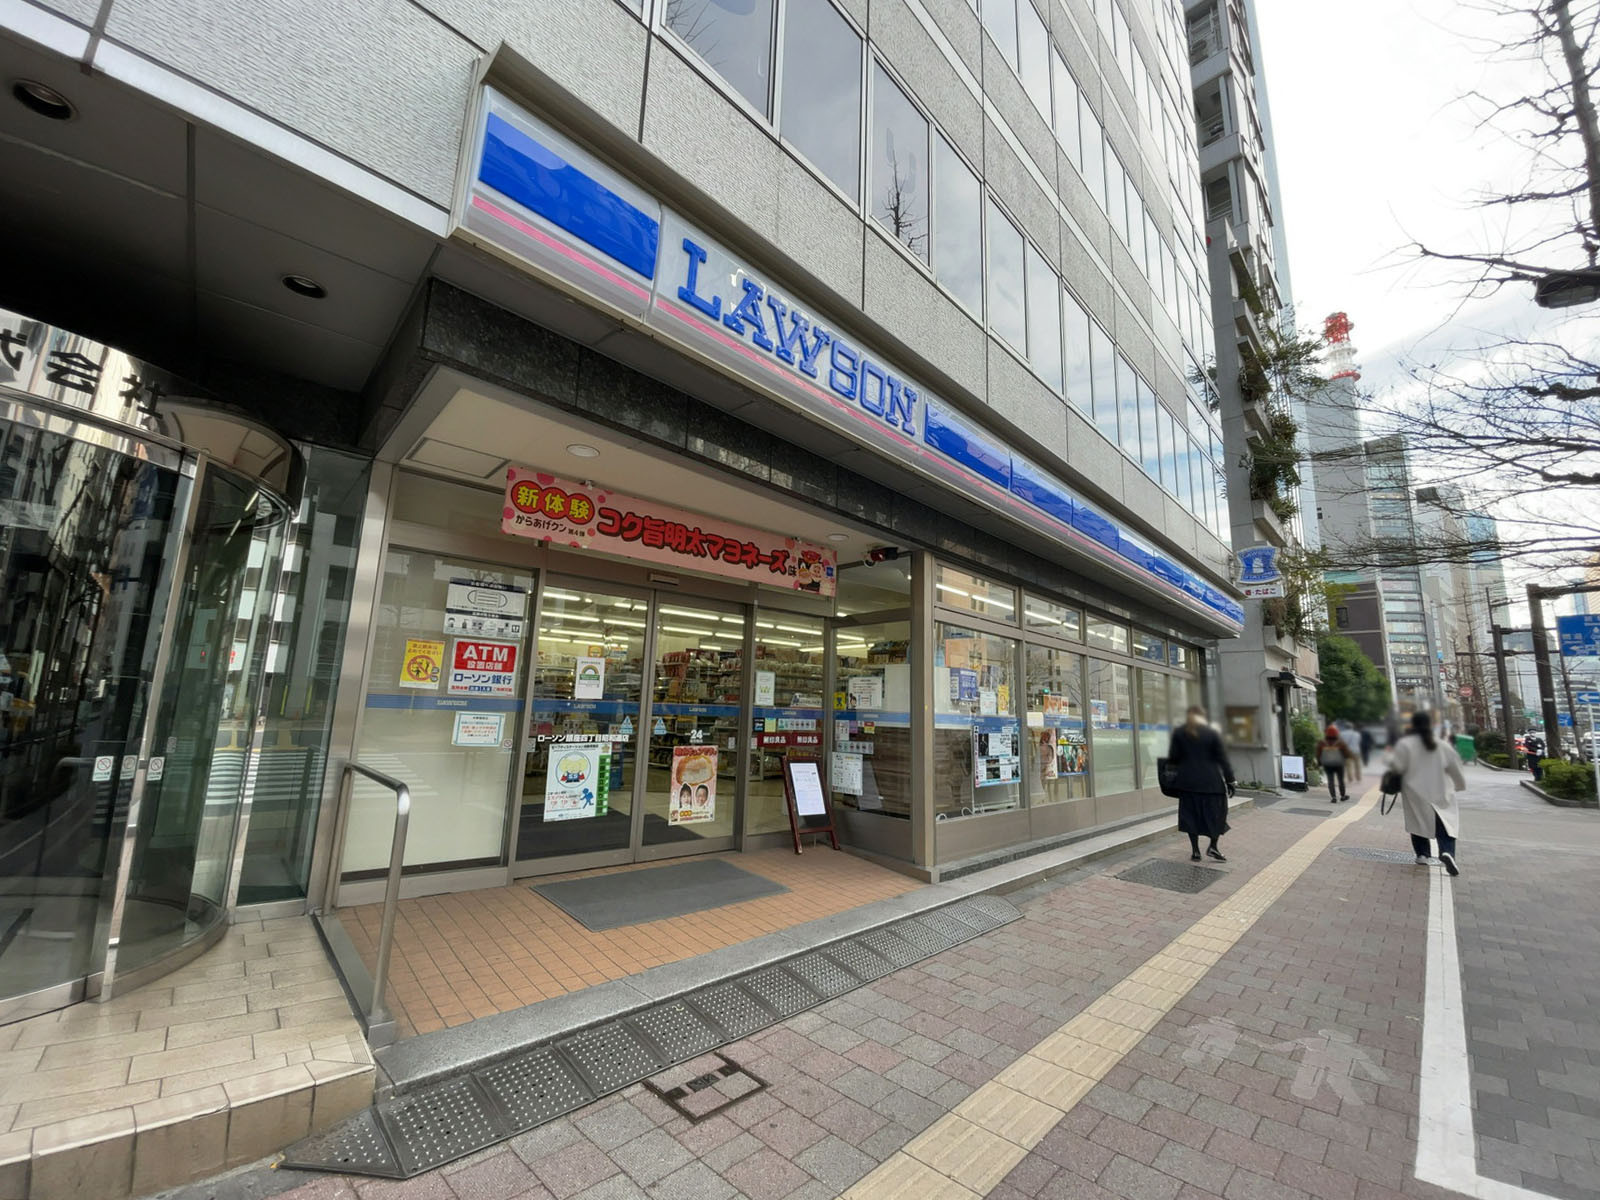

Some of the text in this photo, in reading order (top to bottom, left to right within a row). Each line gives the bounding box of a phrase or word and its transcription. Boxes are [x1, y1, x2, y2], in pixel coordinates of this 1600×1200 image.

[678, 237, 917, 436] LAWSON
[517, 485, 591, 520] 新体験
[515, 514, 568, 532] からあげクン
[462, 645, 509, 662] ATM
[453, 673, 512, 685] ローソン銀行
[690, 729, 703, 739] 24
